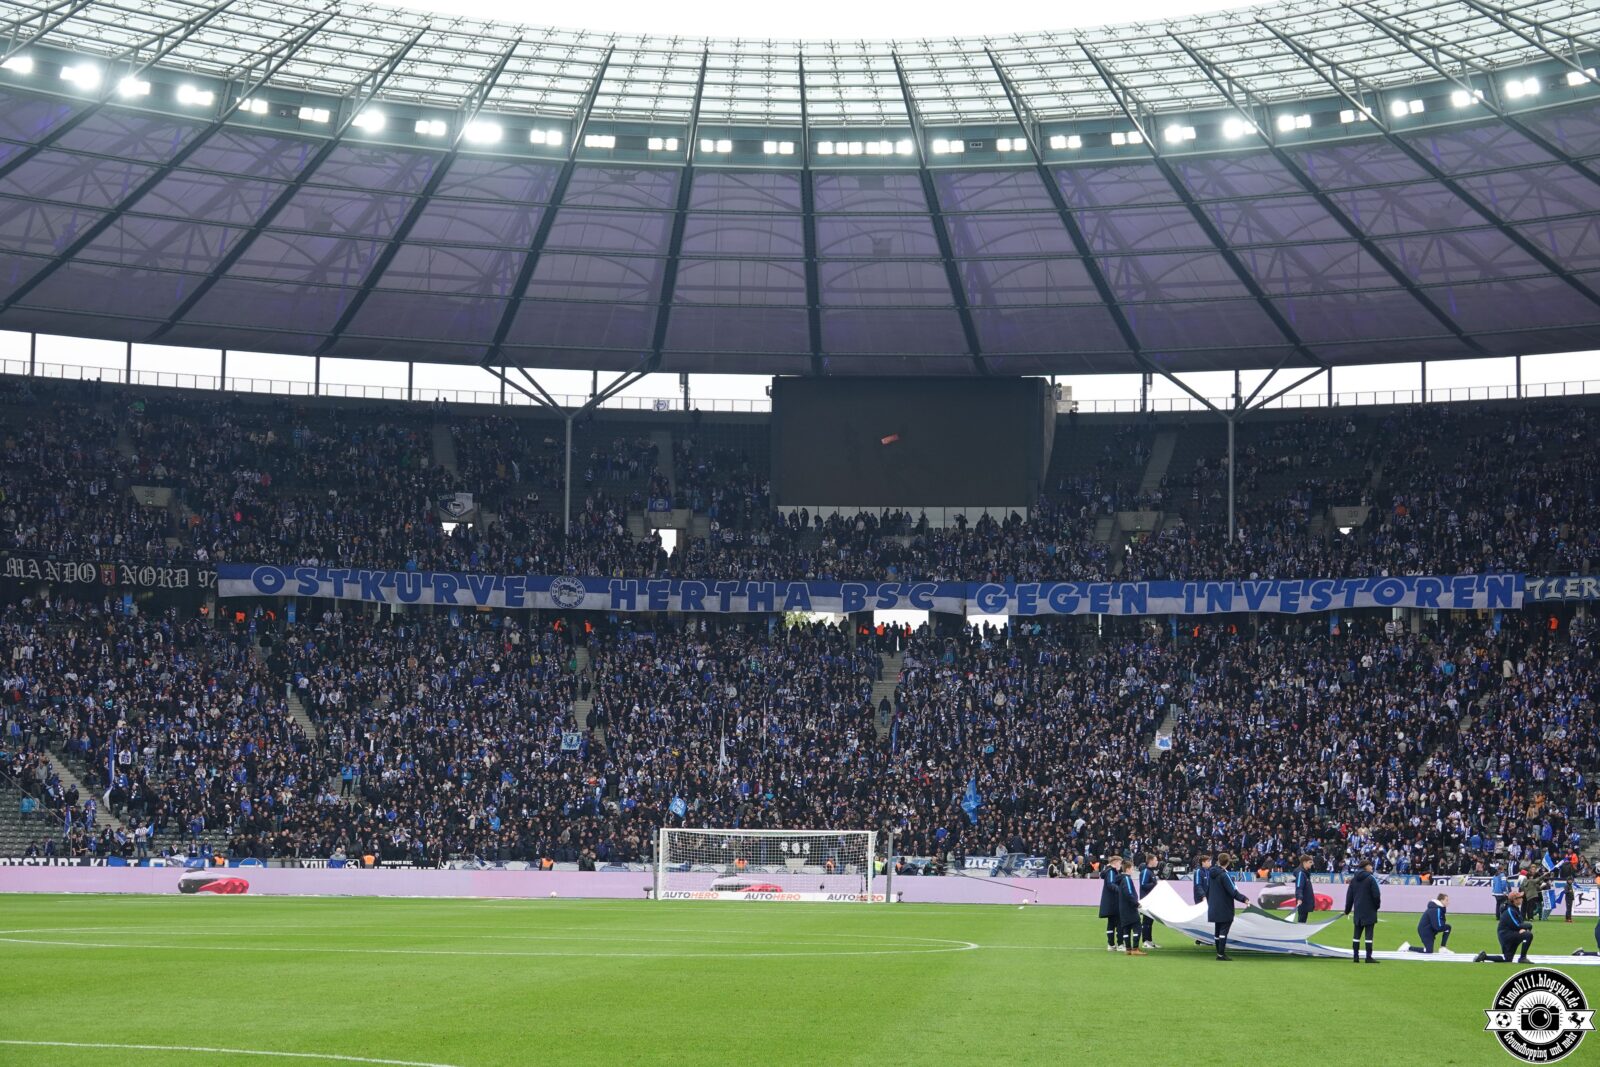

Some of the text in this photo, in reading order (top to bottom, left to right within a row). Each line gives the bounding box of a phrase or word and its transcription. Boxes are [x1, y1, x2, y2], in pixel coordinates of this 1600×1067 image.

[121, 565, 189, 588] NORD
[251, 565, 938, 613] OSTKURVE HERTHA BSC
[976, 574, 1518, 614] GEGEN INVESTOREN
[662, 891, 720, 899] AUTOHERO
